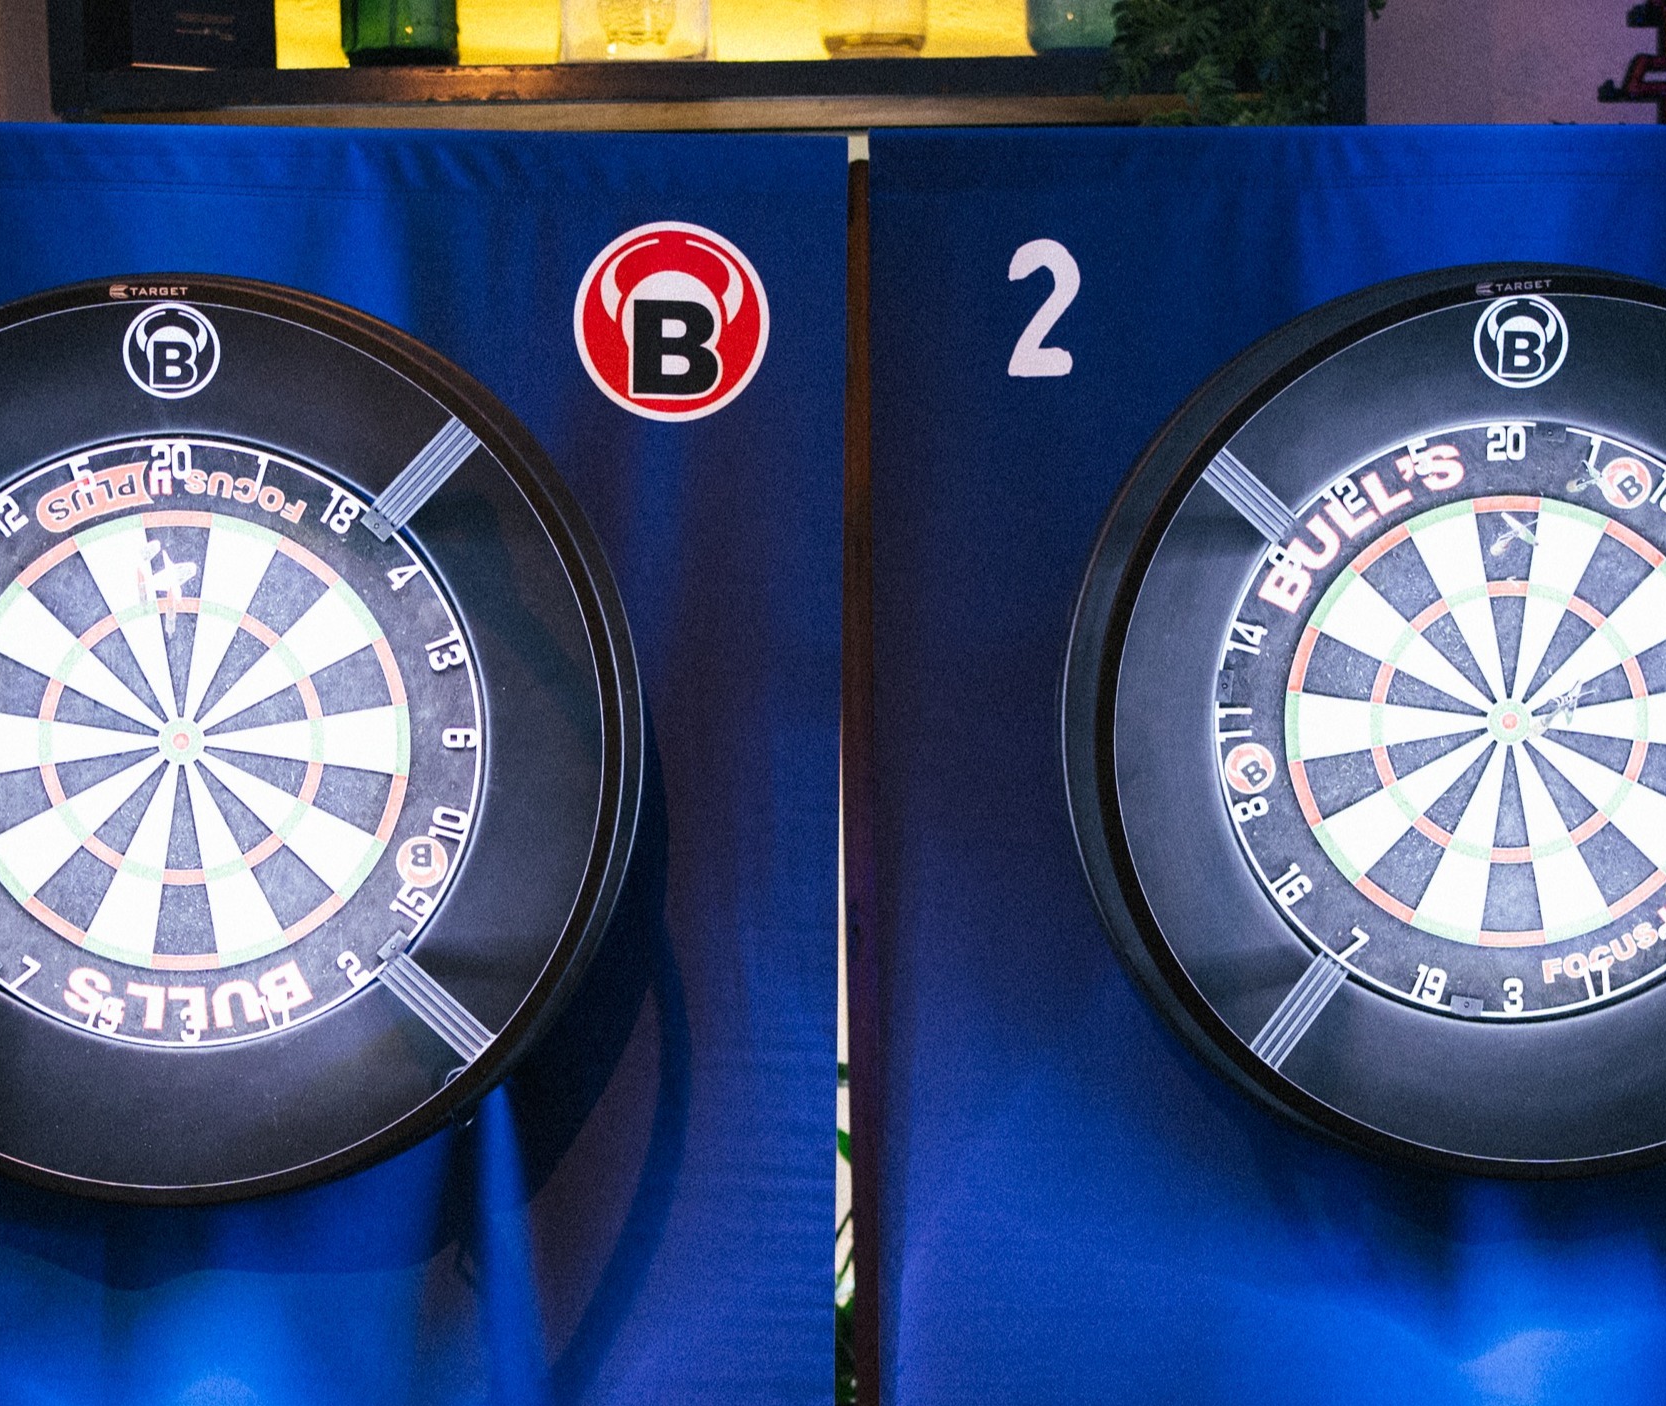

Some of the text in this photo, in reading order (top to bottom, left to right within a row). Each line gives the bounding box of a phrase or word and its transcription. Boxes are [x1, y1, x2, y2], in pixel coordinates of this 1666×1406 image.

[129, 286, 188, 297] TARGET
[1496, 279, 1552, 293] TARGET
[1008, 238, 1080, 377] 2
[633, 299, 719, 395] B
[150, 443, 192, 480] 20
[1407, 438, 1432, 477] 5
[1487, 426, 1526, 461] 20
[1588, 436, 1603, 466] 1
[69, 457, 96, 492] 5
[256, 454, 270, 493] 1
[48, 474, 136, 521] PLUS
[184, 469, 307, 523] FOCUS
[320, 487, 360, 534] 18
[1321, 477, 1367, 514] 12
[387, 562, 422, 591] 4
[424, 629, 466, 671] 13
[1227, 621, 1268, 655] 14
[1219, 706, 1253, 742] 11
[428, 805, 469, 843] 10
[1233, 796, 1269, 822] 8
[390, 882, 436, 924] 15
[1272, 863, 1313, 906] 16
[1339, 927, 1370, 961] 7
[1542, 921, 1659, 984] FOCUS
[9, 955, 42, 992] 7
[337, 951, 372, 988] 2
[1411, 963, 1448, 1004] 19
[1579, 959, 1612, 1001] 17
[1502, 978, 1524, 1014] 3
